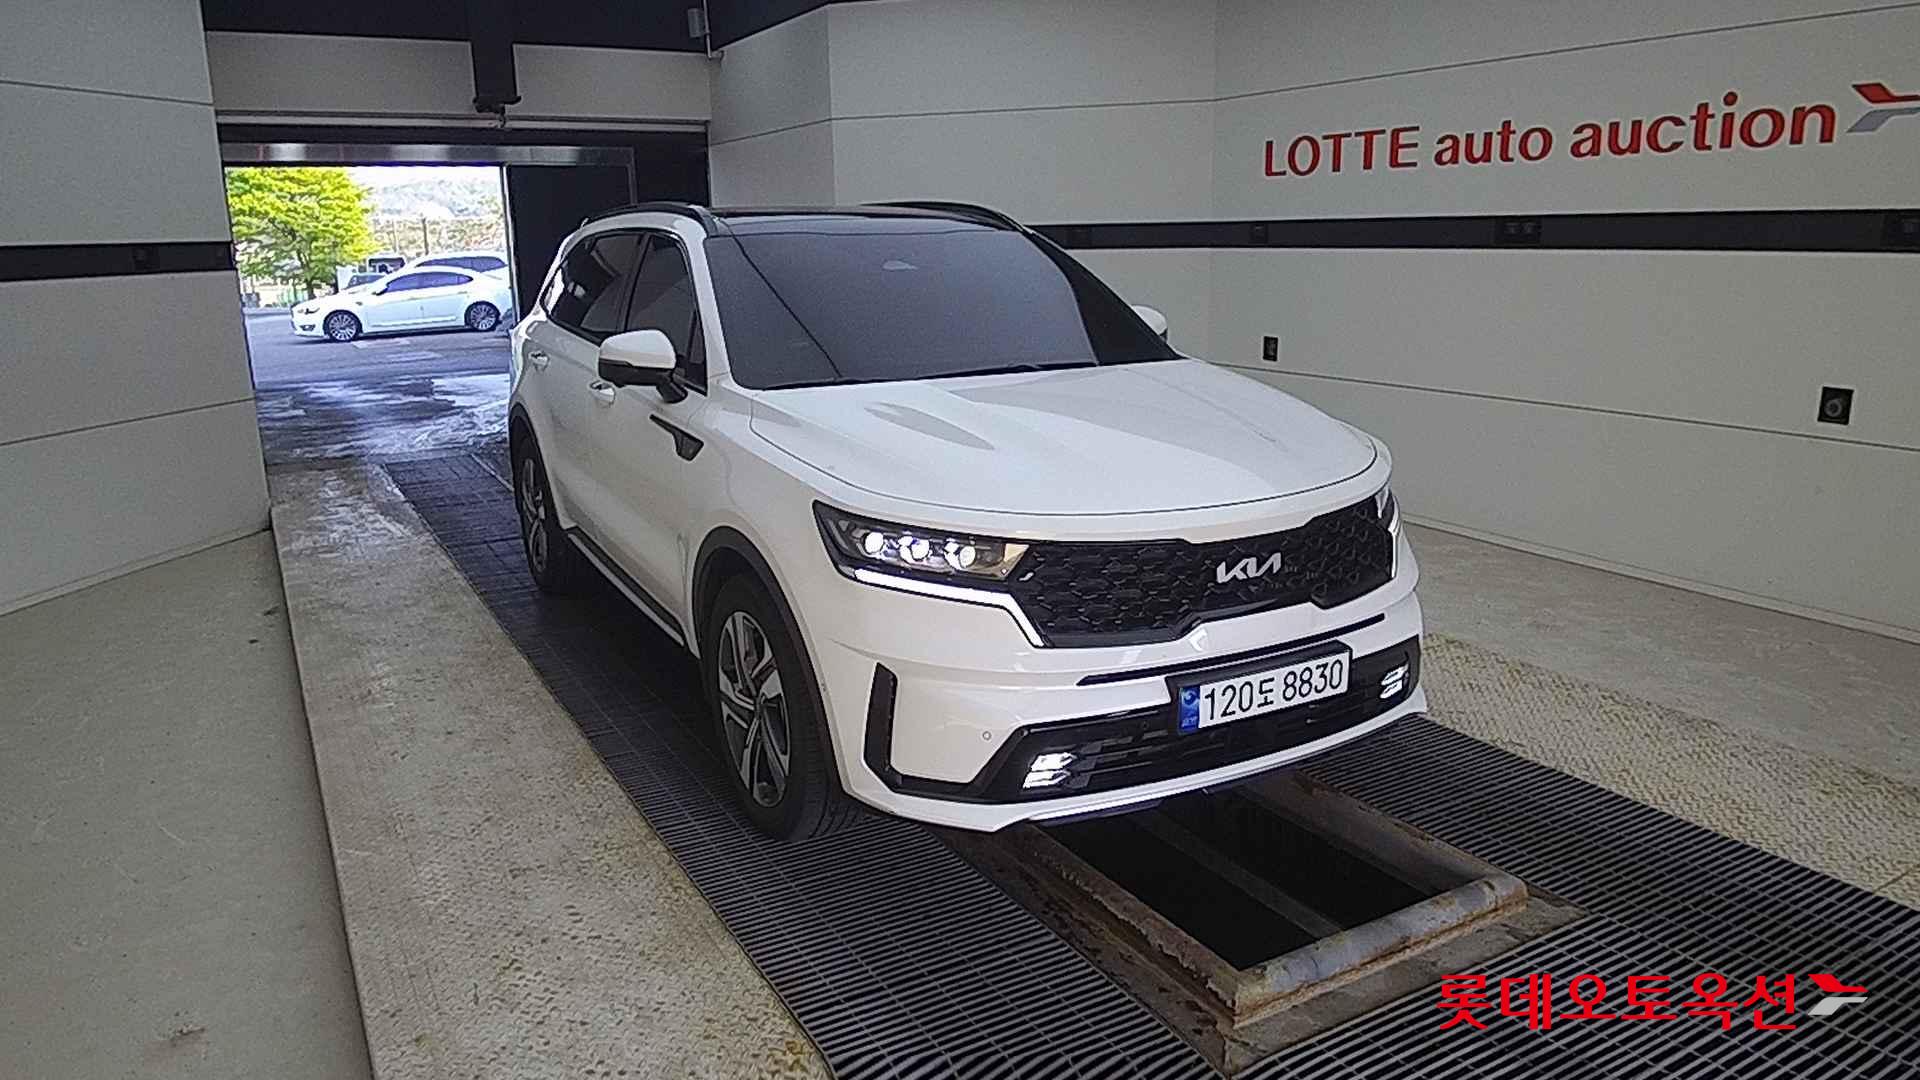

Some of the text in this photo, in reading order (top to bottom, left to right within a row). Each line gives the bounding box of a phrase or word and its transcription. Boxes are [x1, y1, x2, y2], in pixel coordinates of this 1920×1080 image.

[1264, 91, 1837, 177] LOTTE auto auction
[1204, 658, 1344, 720] 120도 8830
